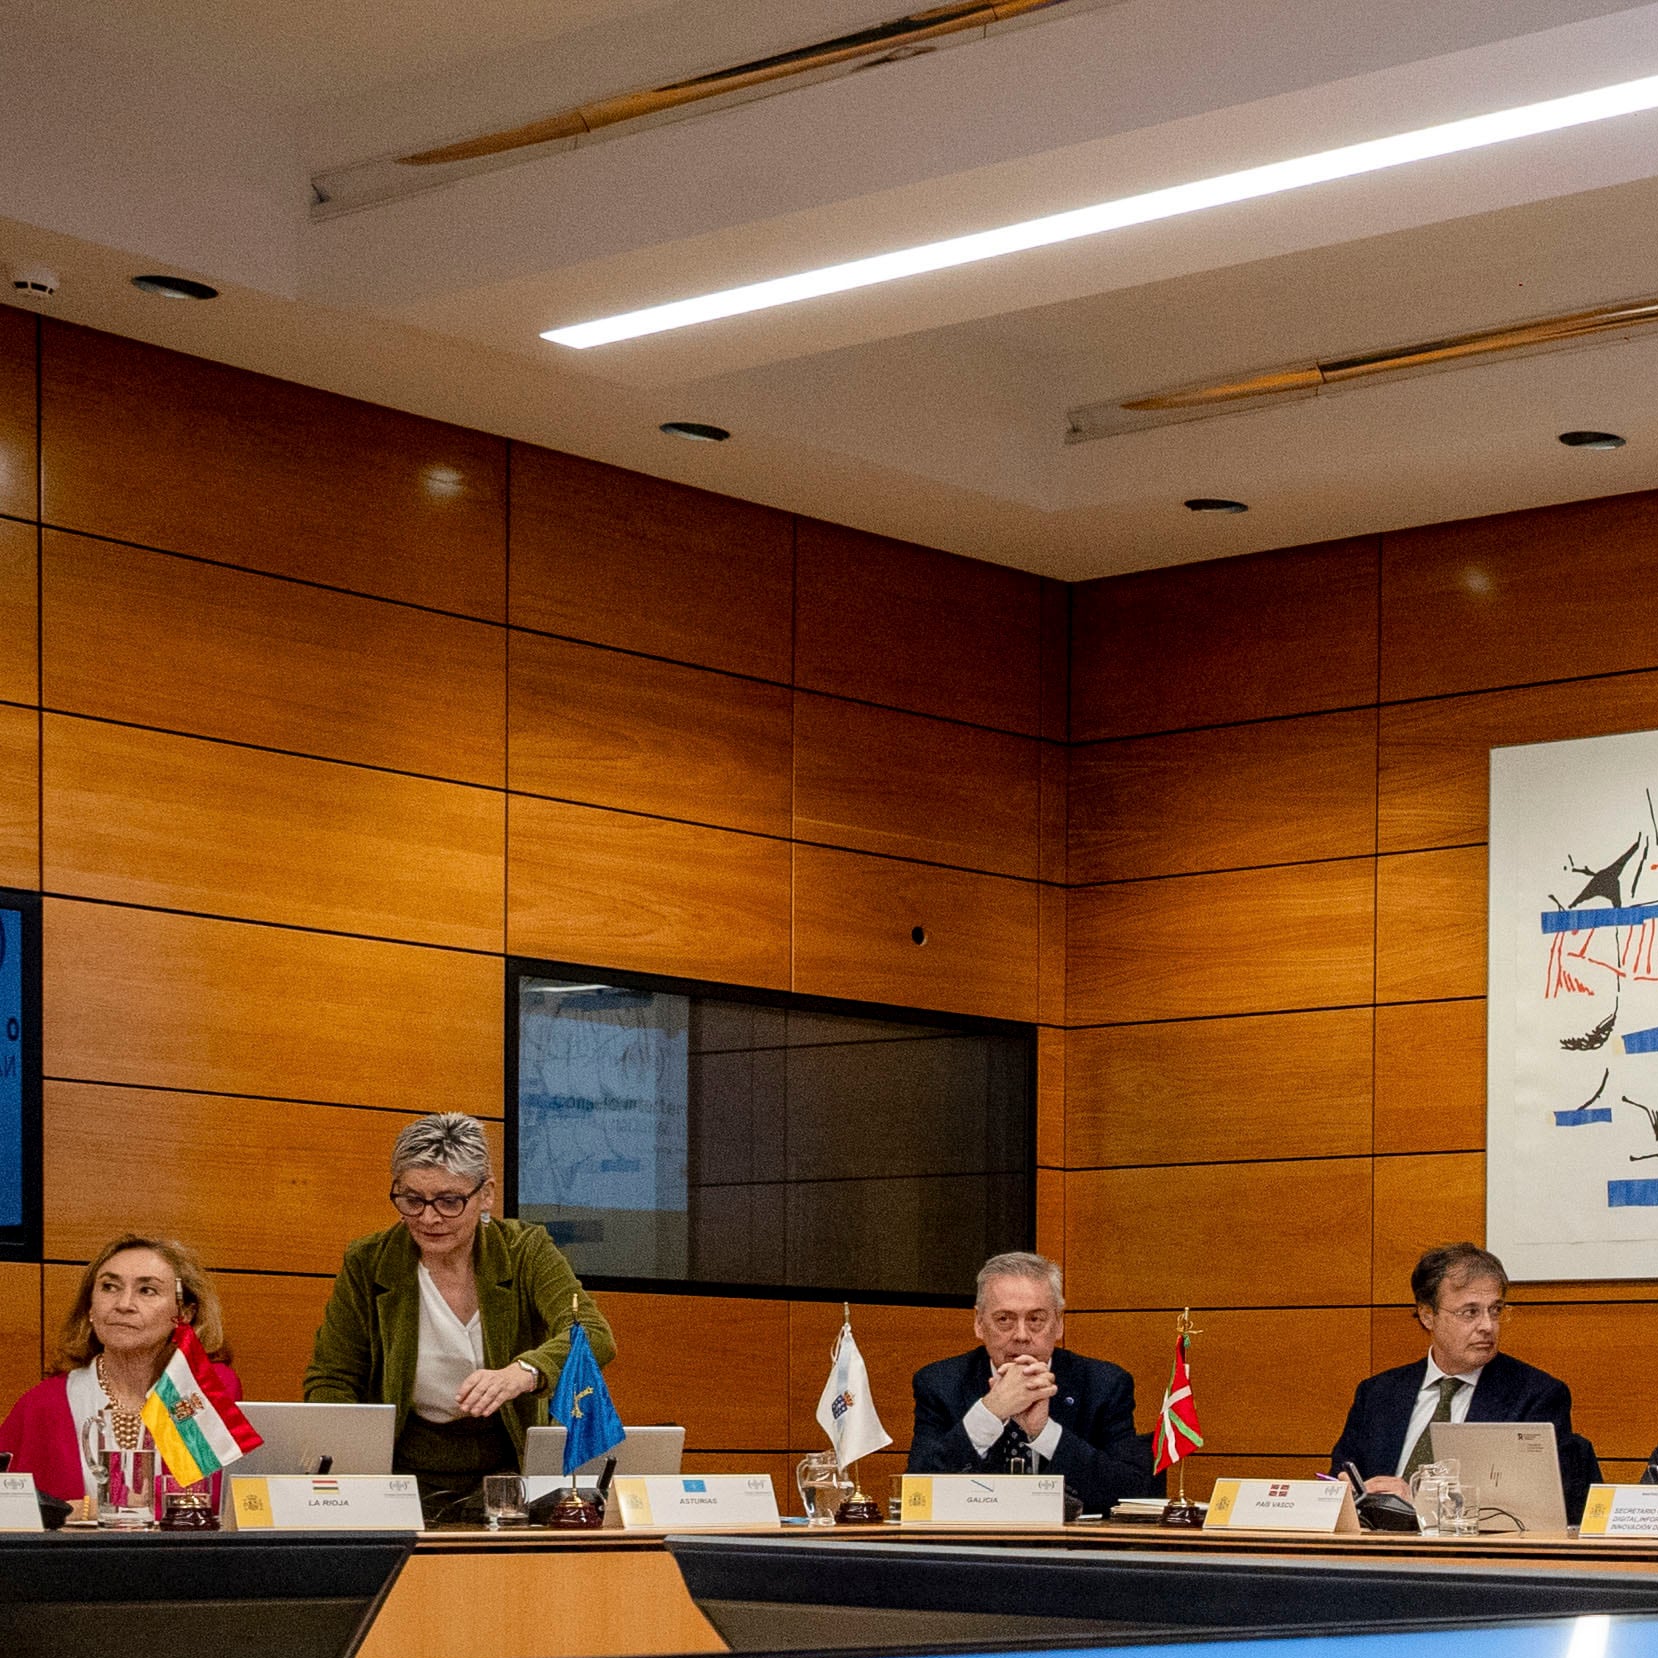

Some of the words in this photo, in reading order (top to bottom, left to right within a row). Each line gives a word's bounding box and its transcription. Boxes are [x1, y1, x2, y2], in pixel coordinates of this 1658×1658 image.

[308, 1499, 320, 1507] LA
[322, 1499, 350, 1507] RIOJA
[966, 1496, 998, 1504] GALICIA
[1272, 1501, 1296, 1509] VASCO
